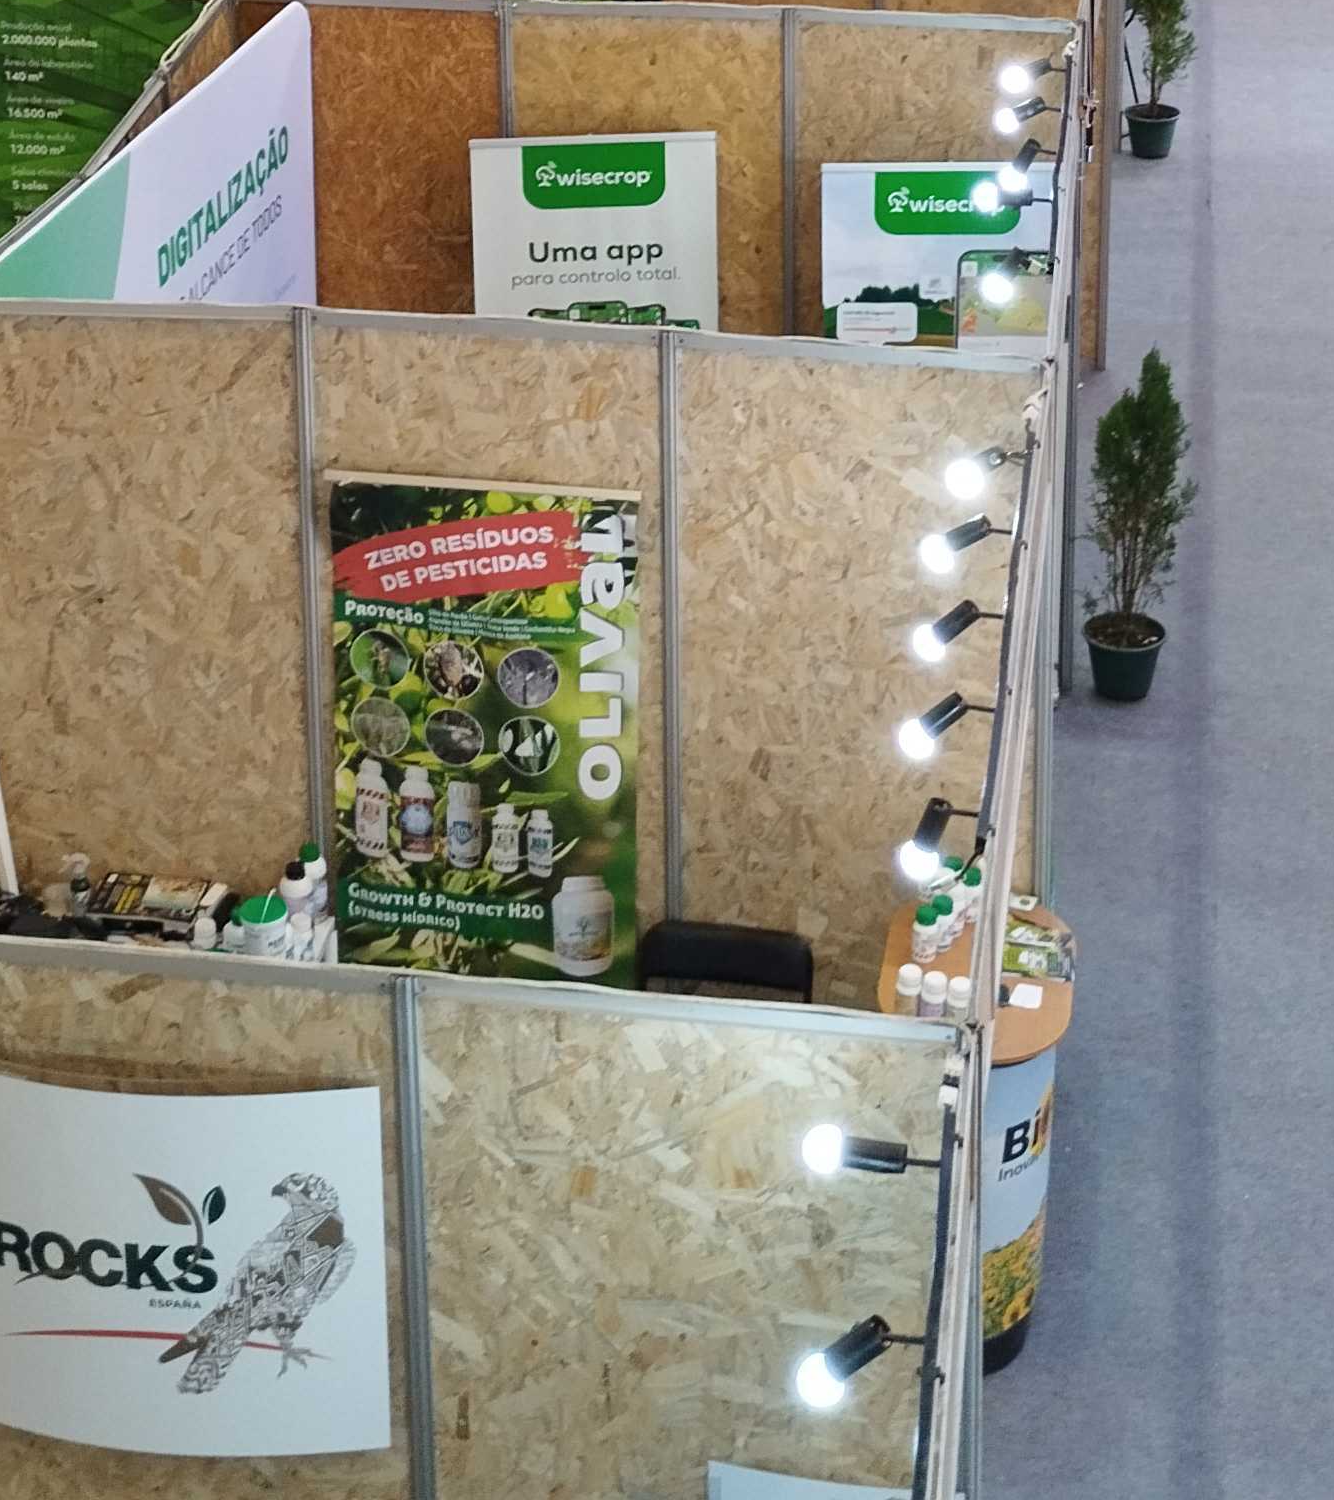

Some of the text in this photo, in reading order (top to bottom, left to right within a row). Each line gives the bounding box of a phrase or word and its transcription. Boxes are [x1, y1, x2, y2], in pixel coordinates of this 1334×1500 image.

[1, 34, 57, 47] 2.000.000
[4, 70, 26, 82] 140
[555, 165, 652, 188] wisecrop
[157, 125, 289, 289] DIGITALIZAÇÃO
[528, 240, 664, 266] Uma app
[511, 265, 682, 290] para controlo total.
[364, 524, 555, 570] ZERO RESÍDUOS
[380, 550, 548, 592] DE PESTICIDAS
[508, 901, 545, 920] H2O
[148, 1297, 202, 1310] ESPAÑA
